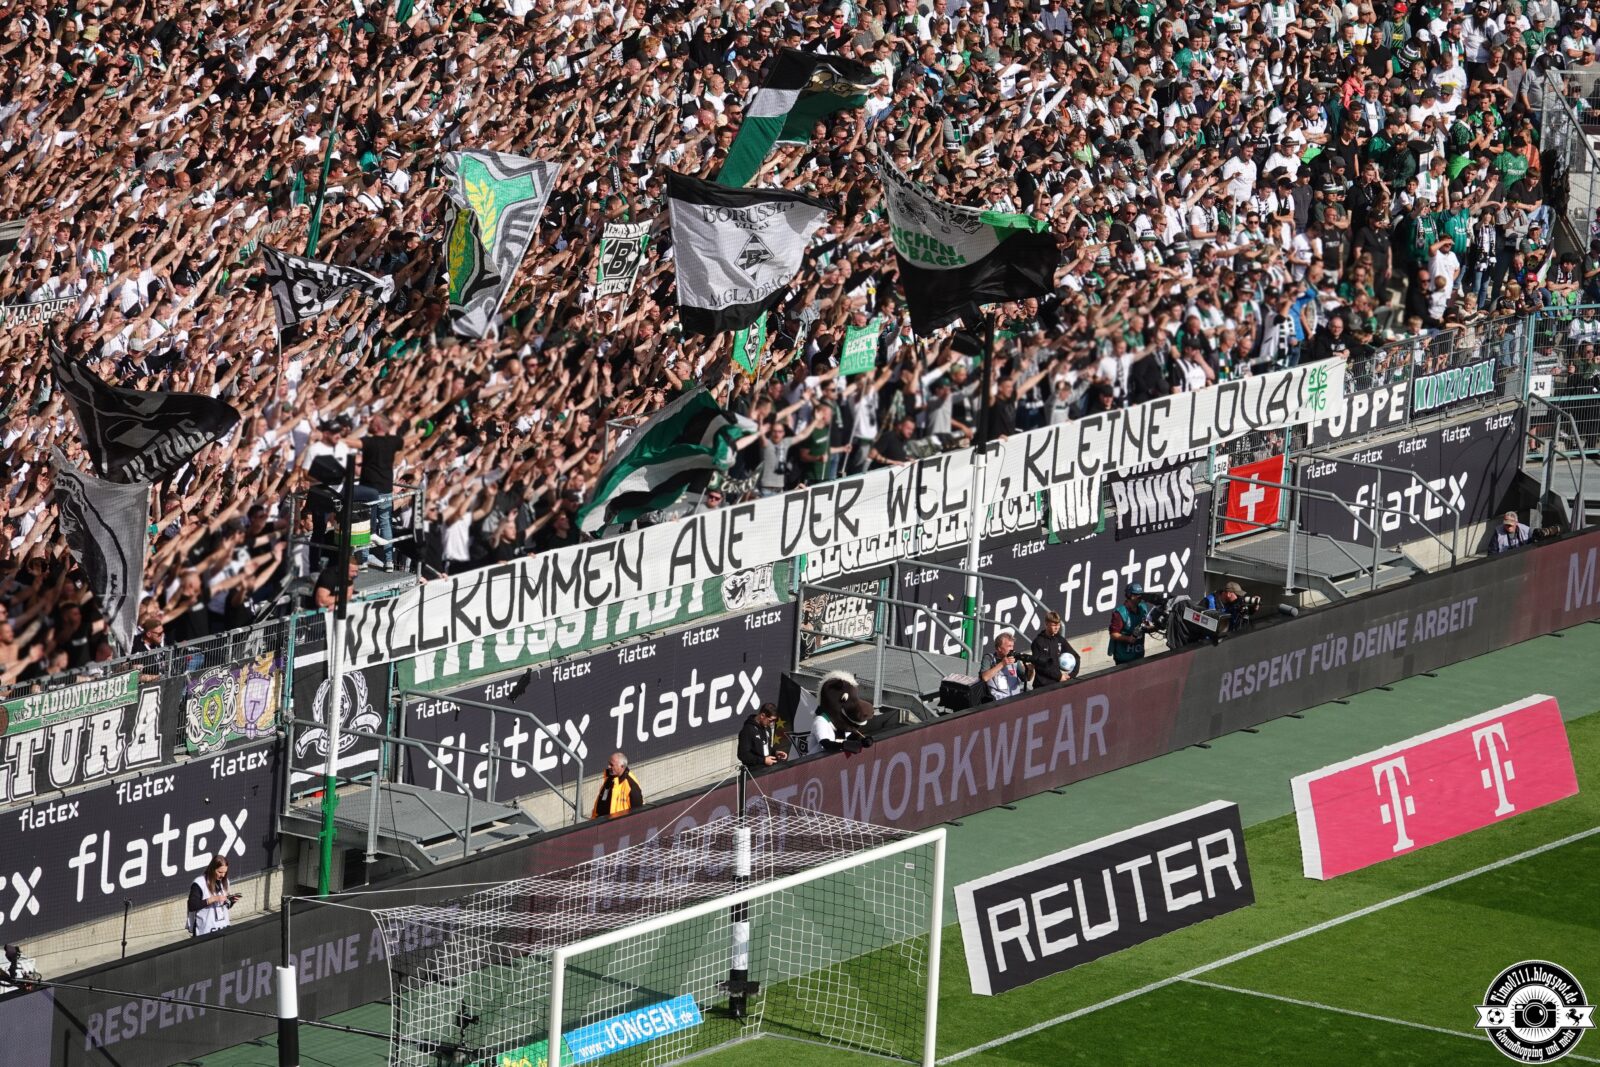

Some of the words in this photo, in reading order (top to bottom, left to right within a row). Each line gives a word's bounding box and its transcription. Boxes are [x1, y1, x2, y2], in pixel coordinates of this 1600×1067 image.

[1414, 358, 1495, 412] KINZIGTAL
[1534, 381, 1546, 391] 14
[1397, 437, 1427, 455] flatex
[1441, 425, 1471, 443] flatex
[780, 478, 864, 557] DER
[1022, 399, 1171, 492] KLEINE
[1306, 462, 1337, 480] flatex
[1111, 466, 1195, 530] PINKIS
[1350, 471, 1468, 541] flatex
[958, 553, 993, 571] flex
[1012, 539, 1046, 559] flatex
[904, 568, 940, 588] flatex
[1060, 547, 1191, 623] flatex
[1563, 546, 1600, 613] M
[744, 610, 782, 631] flatex
[825, 596, 869, 623] GEHT
[905, 589, 1043, 657] flaex
[617, 643, 657, 665] flatex
[681, 626, 720, 648] flatex
[1218, 650, 1306, 703] RESPEKT
[1309, 633, 1349, 676] FÜR
[1352, 617, 1408, 663] DEINE
[1412, 596, 1478, 643] ARBEIT
[23, 672, 131, 721] STADIONVERBOT
[552, 662, 592, 683] flatex
[609, 665, 763, 749] flatex
[0, 686, 163, 804] TURA
[210, 749, 268, 780] flatex
[427, 713, 591, 794] flatex
[840, 694, 1110, 825] WORKWEAR
[116, 774, 175, 806] flatex
[18, 800, 80, 832] flatex
[68, 808, 248, 903] flatex
[987, 828, 1243, 973] REUTER
[84, 977, 213, 1052] RESPEKT
[218, 955, 274, 1008] FÜR
